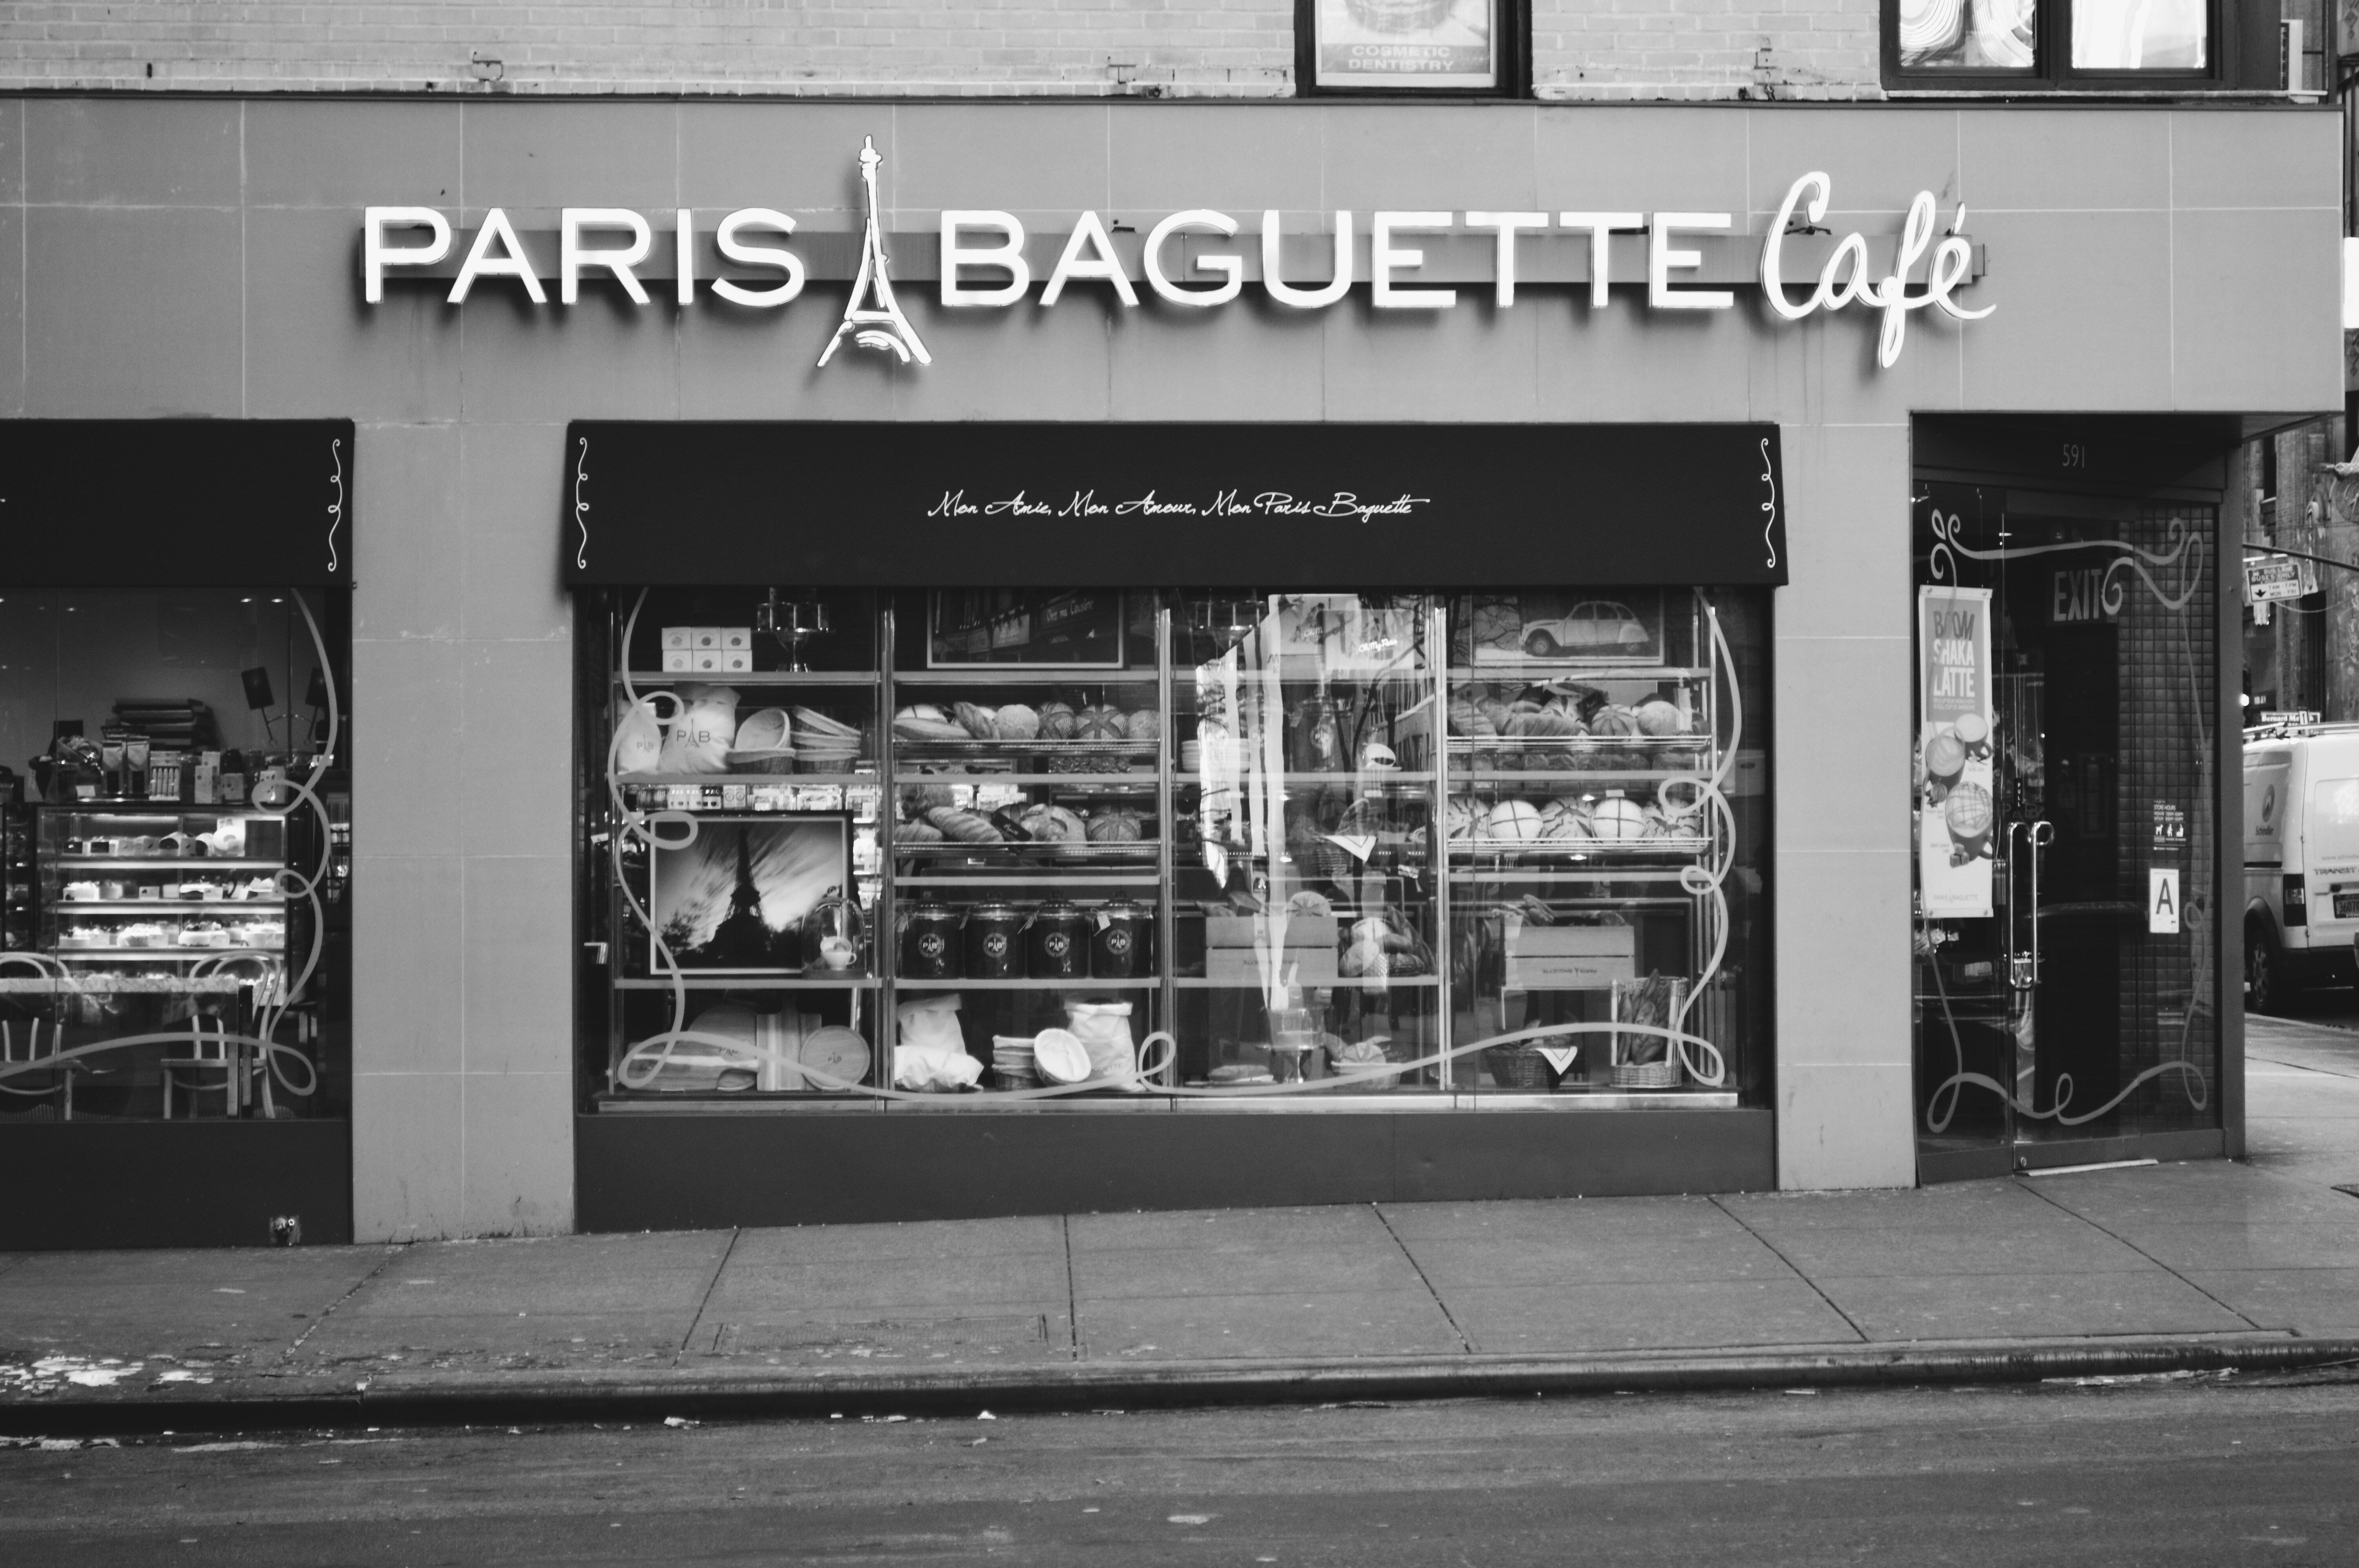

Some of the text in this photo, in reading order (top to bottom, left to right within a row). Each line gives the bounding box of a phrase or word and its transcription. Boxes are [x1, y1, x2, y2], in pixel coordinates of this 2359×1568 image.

[1349, 59, 1454, 71] DENTISTRY
[1352, 45, 1450, 57] COSMETIC
[365, 171, 1997, 368] PARIS BAGUETTE Café
[2062, 443, 2085, 468] 591
[927, 489, 978, 517] Mon
[1058, 489, 1109, 517] Mon
[1201, 489, 1252, 516] Mon
[1254, 492, 1311, 515] Paris
[1313, 492, 1431, 523] Baguette
[2054, 568, 2103, 621] EXIT
[1933, 639, 1975, 666] SHAKA
[1933, 666, 1975, 697] LATTE
[2314, 866, 2357, 875] TRANSIT
[2156, 878, 2174, 915] A
